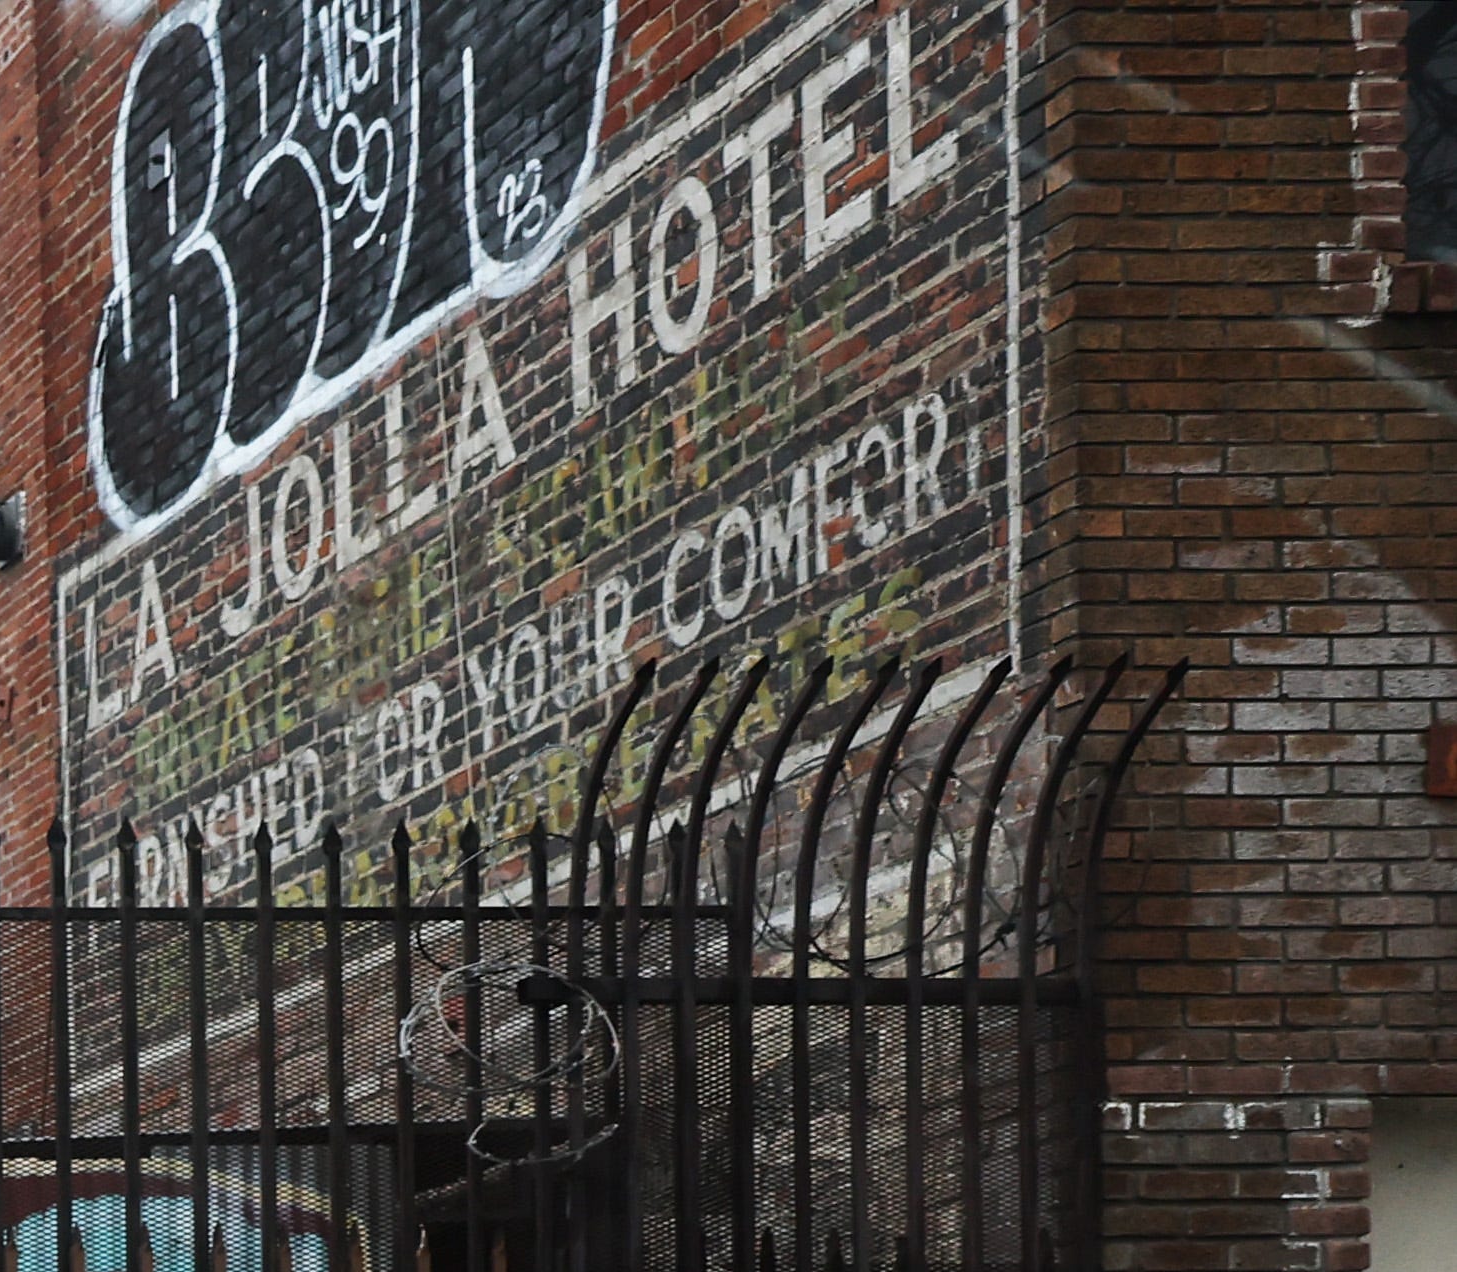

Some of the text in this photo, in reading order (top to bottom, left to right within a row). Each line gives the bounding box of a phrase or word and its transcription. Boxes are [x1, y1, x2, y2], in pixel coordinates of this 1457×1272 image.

[84, 557, 177, 732] LA
[219, 326, 518, 637] JOLLA
[565, 5, 960, 415] HOTEL
[344, 680, 446, 802] FOR
[466, 574, 631, 754] YOUR
[663, 365, 989, 649] COMFORT
